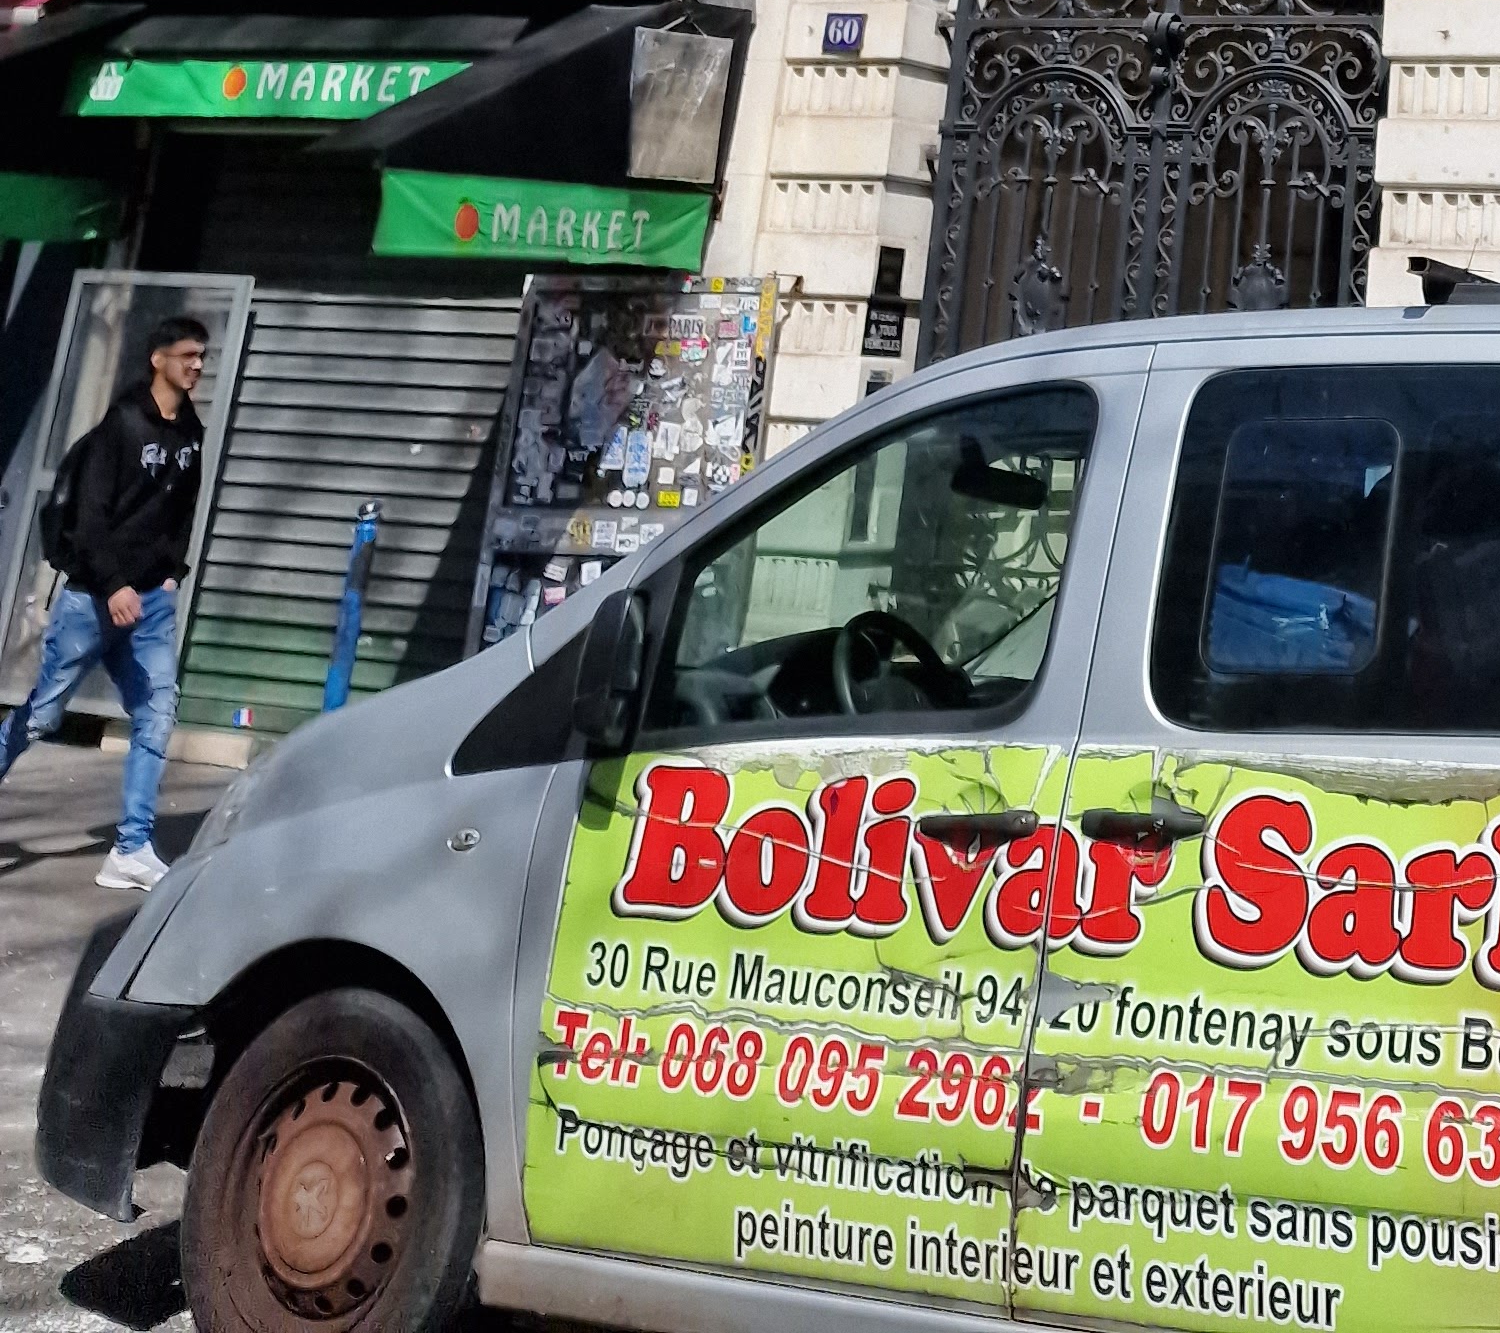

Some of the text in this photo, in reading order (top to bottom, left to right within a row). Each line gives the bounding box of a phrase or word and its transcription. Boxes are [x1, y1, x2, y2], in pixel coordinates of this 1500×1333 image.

[256, 62, 431, 103] MARKET
[828, 18, 859, 45] 60
[491, 202, 650, 252] MARKET
[613, 761, 1173, 953] Bolivar
[586, 942, 628, 989] 30
[643, 948, 716, 997] Rue
[731, 952, 963, 1022] Mauconseil
[1116, 986, 1313, 1065] fontenay
[1328, 1018, 1441, 1067] sous
[661, 1022, 764, 1097] 068
[778, 1035, 885, 1112] 095
[1141, 1072, 1261, 1154] 017
[1281, 1085, 1402, 1171] 956
[558, 1108, 714, 1178] Ponçage
[728, 1133, 760, 1174] et
[1071, 1180, 1235, 1236] parquet
[1248, 1199, 1354, 1249] sans
[737, 1205, 1341, 1328] peinture interieur et exterieur
